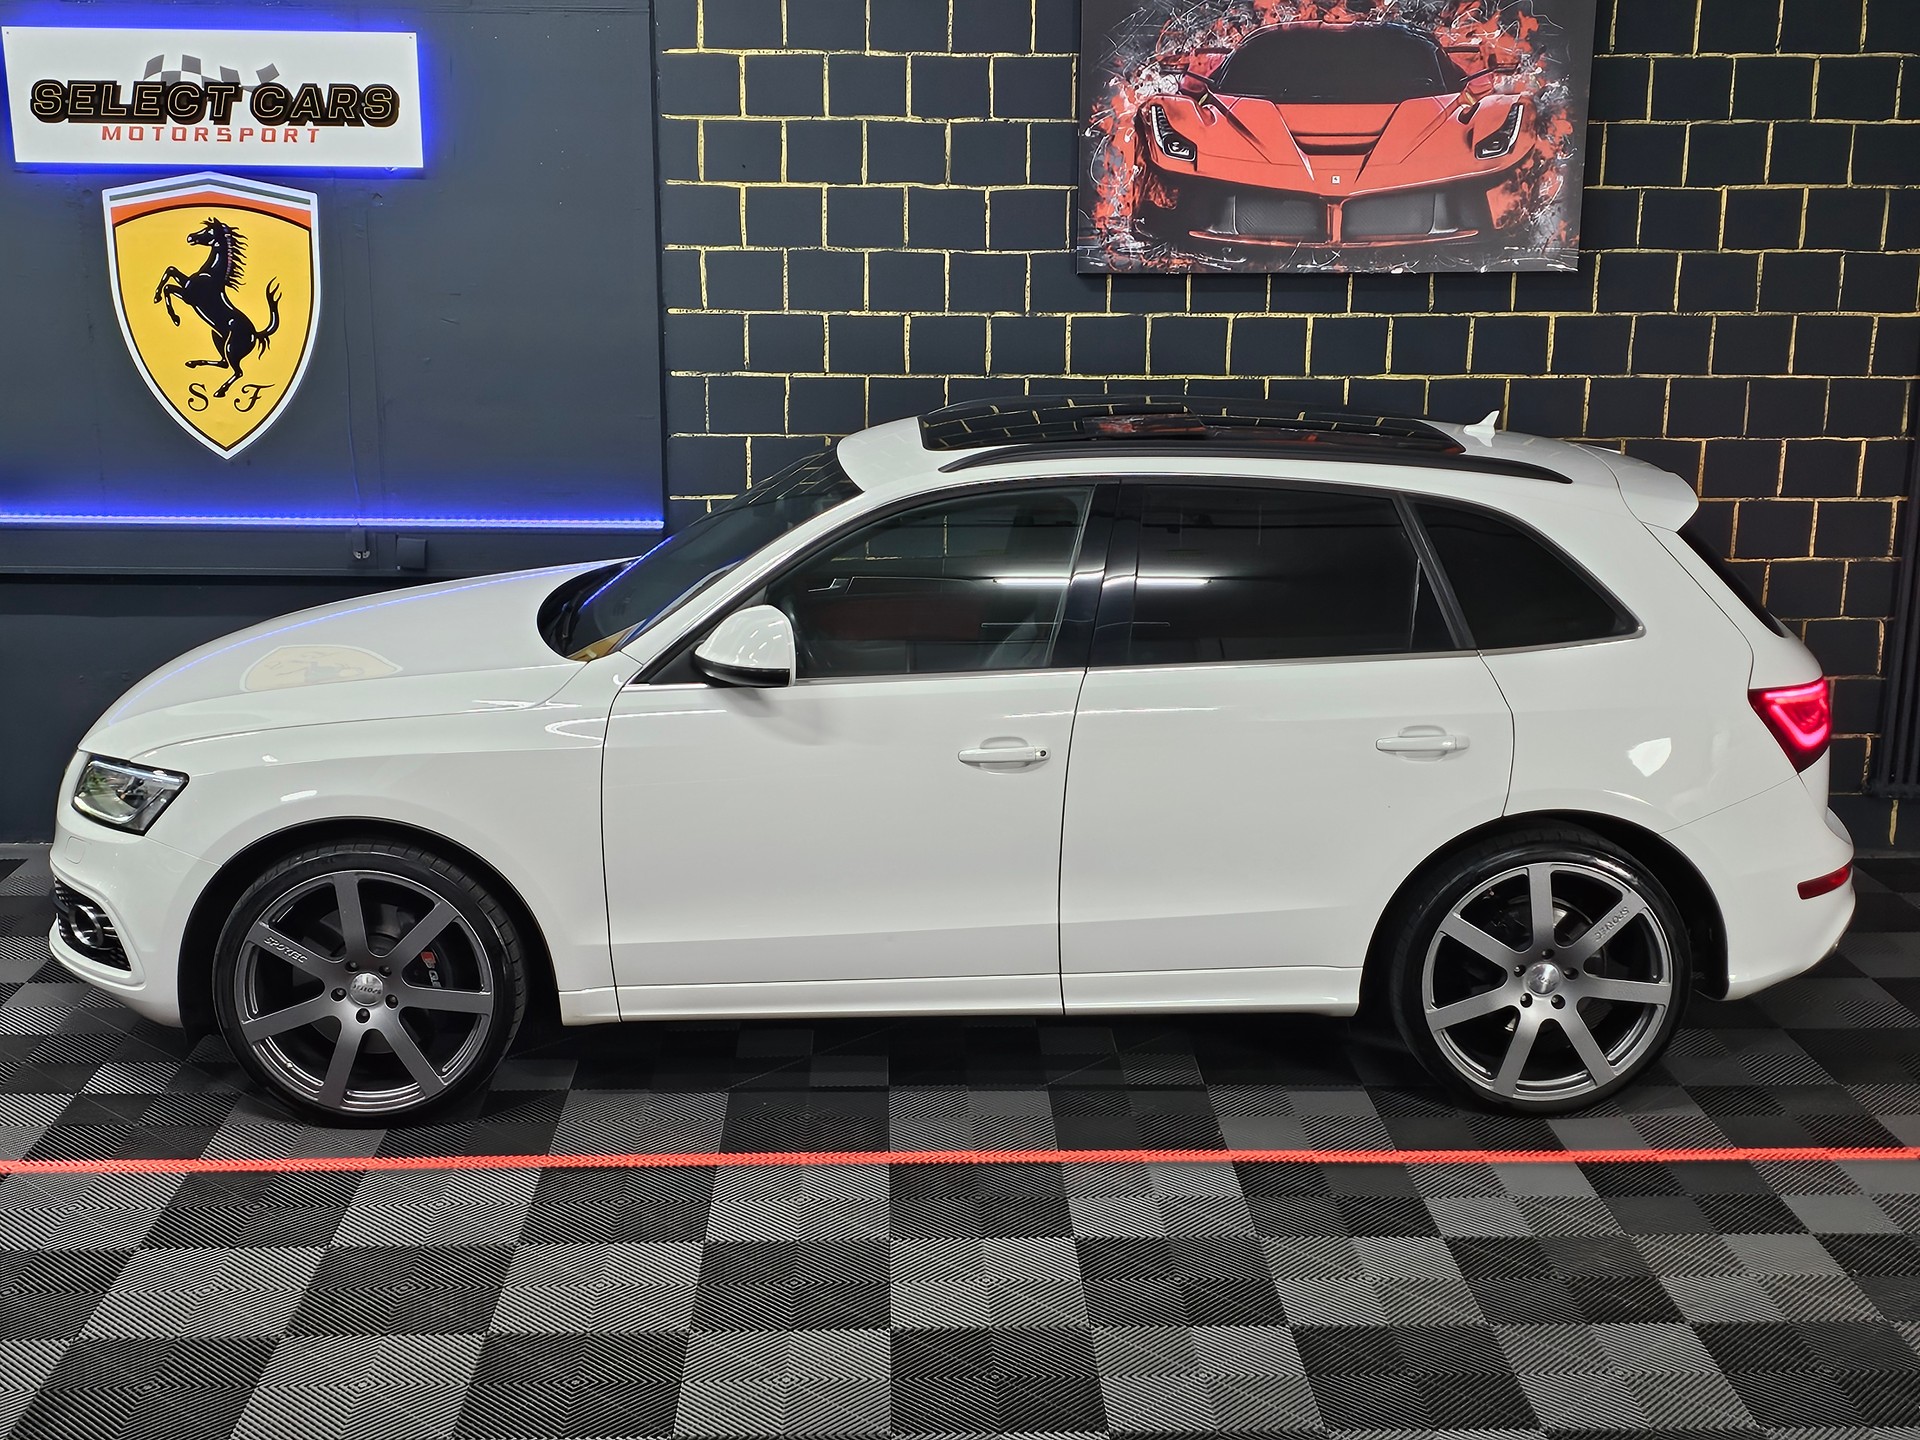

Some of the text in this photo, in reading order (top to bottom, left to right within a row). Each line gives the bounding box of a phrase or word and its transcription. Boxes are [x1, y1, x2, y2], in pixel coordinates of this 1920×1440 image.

[31, 80, 400, 127] SELECT CARS
[101, 126, 320, 143] MOTORSPORT
[187, 382, 276, 413] S F
